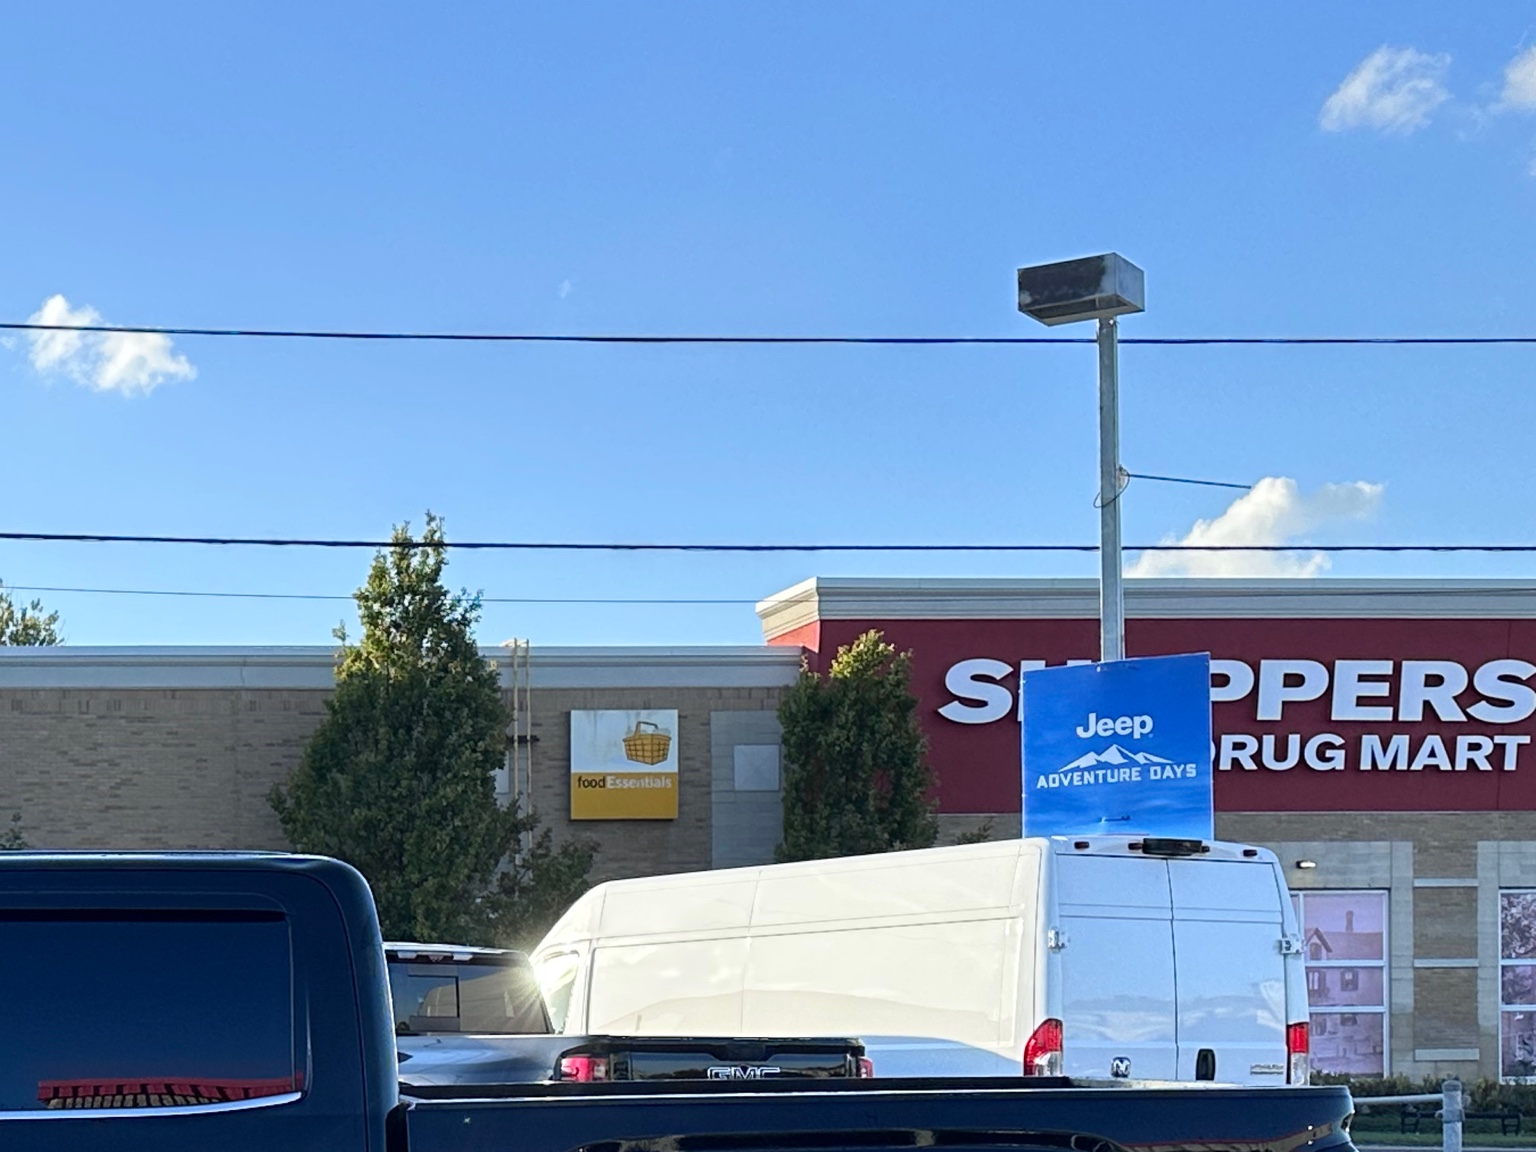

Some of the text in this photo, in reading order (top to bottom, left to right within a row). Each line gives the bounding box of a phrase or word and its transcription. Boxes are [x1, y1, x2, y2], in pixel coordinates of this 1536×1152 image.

[937, 658, 1536, 724] SPPERS
[1076, 712, 1154, 739] Jeep
[1211, 732, 1531, 771] RUG MART
[1036, 763, 1197, 789] ADVENTURE DAYS
[707, 1066, 781, 1080] GMC
